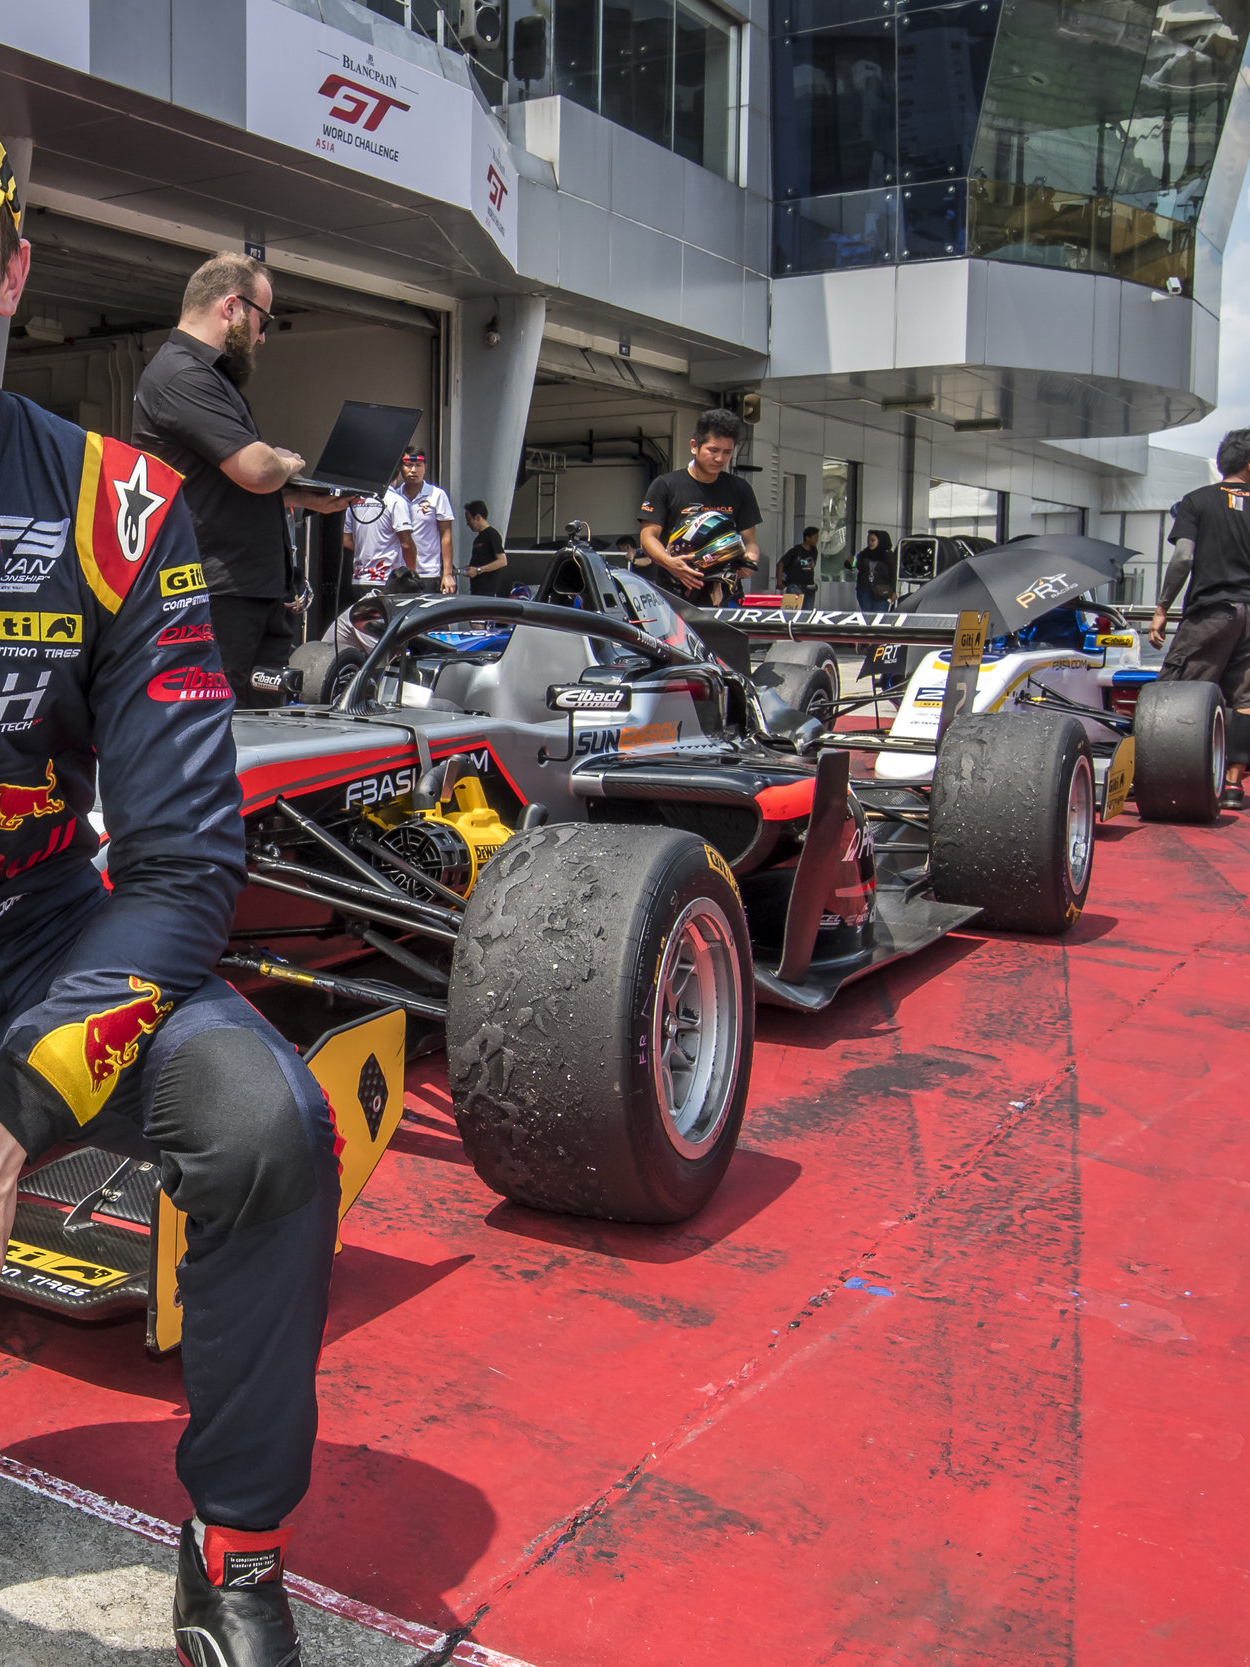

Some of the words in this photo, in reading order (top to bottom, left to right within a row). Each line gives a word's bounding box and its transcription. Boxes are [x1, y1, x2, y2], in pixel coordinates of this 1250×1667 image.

[342, 54, 397, 88] BLANCPAIN
[318, 73, 411, 131] GT
[315, 138, 335, 153] ASIA
[322, 123, 353, 145] WORLD
[354, 136, 400, 162] CHALLENGE
[1016, 573, 1069, 608] PRT
[1051, 583, 1078, 598] RACING
[44, 649, 81, 659] TIRES
[873, 644, 902, 662] PRT
[147, 667, 231, 701] Eibach
[252, 671, 281, 689] Eibach
[556, 690, 624, 708] Eibach
[28, 1274, 91, 1297] TIRES
